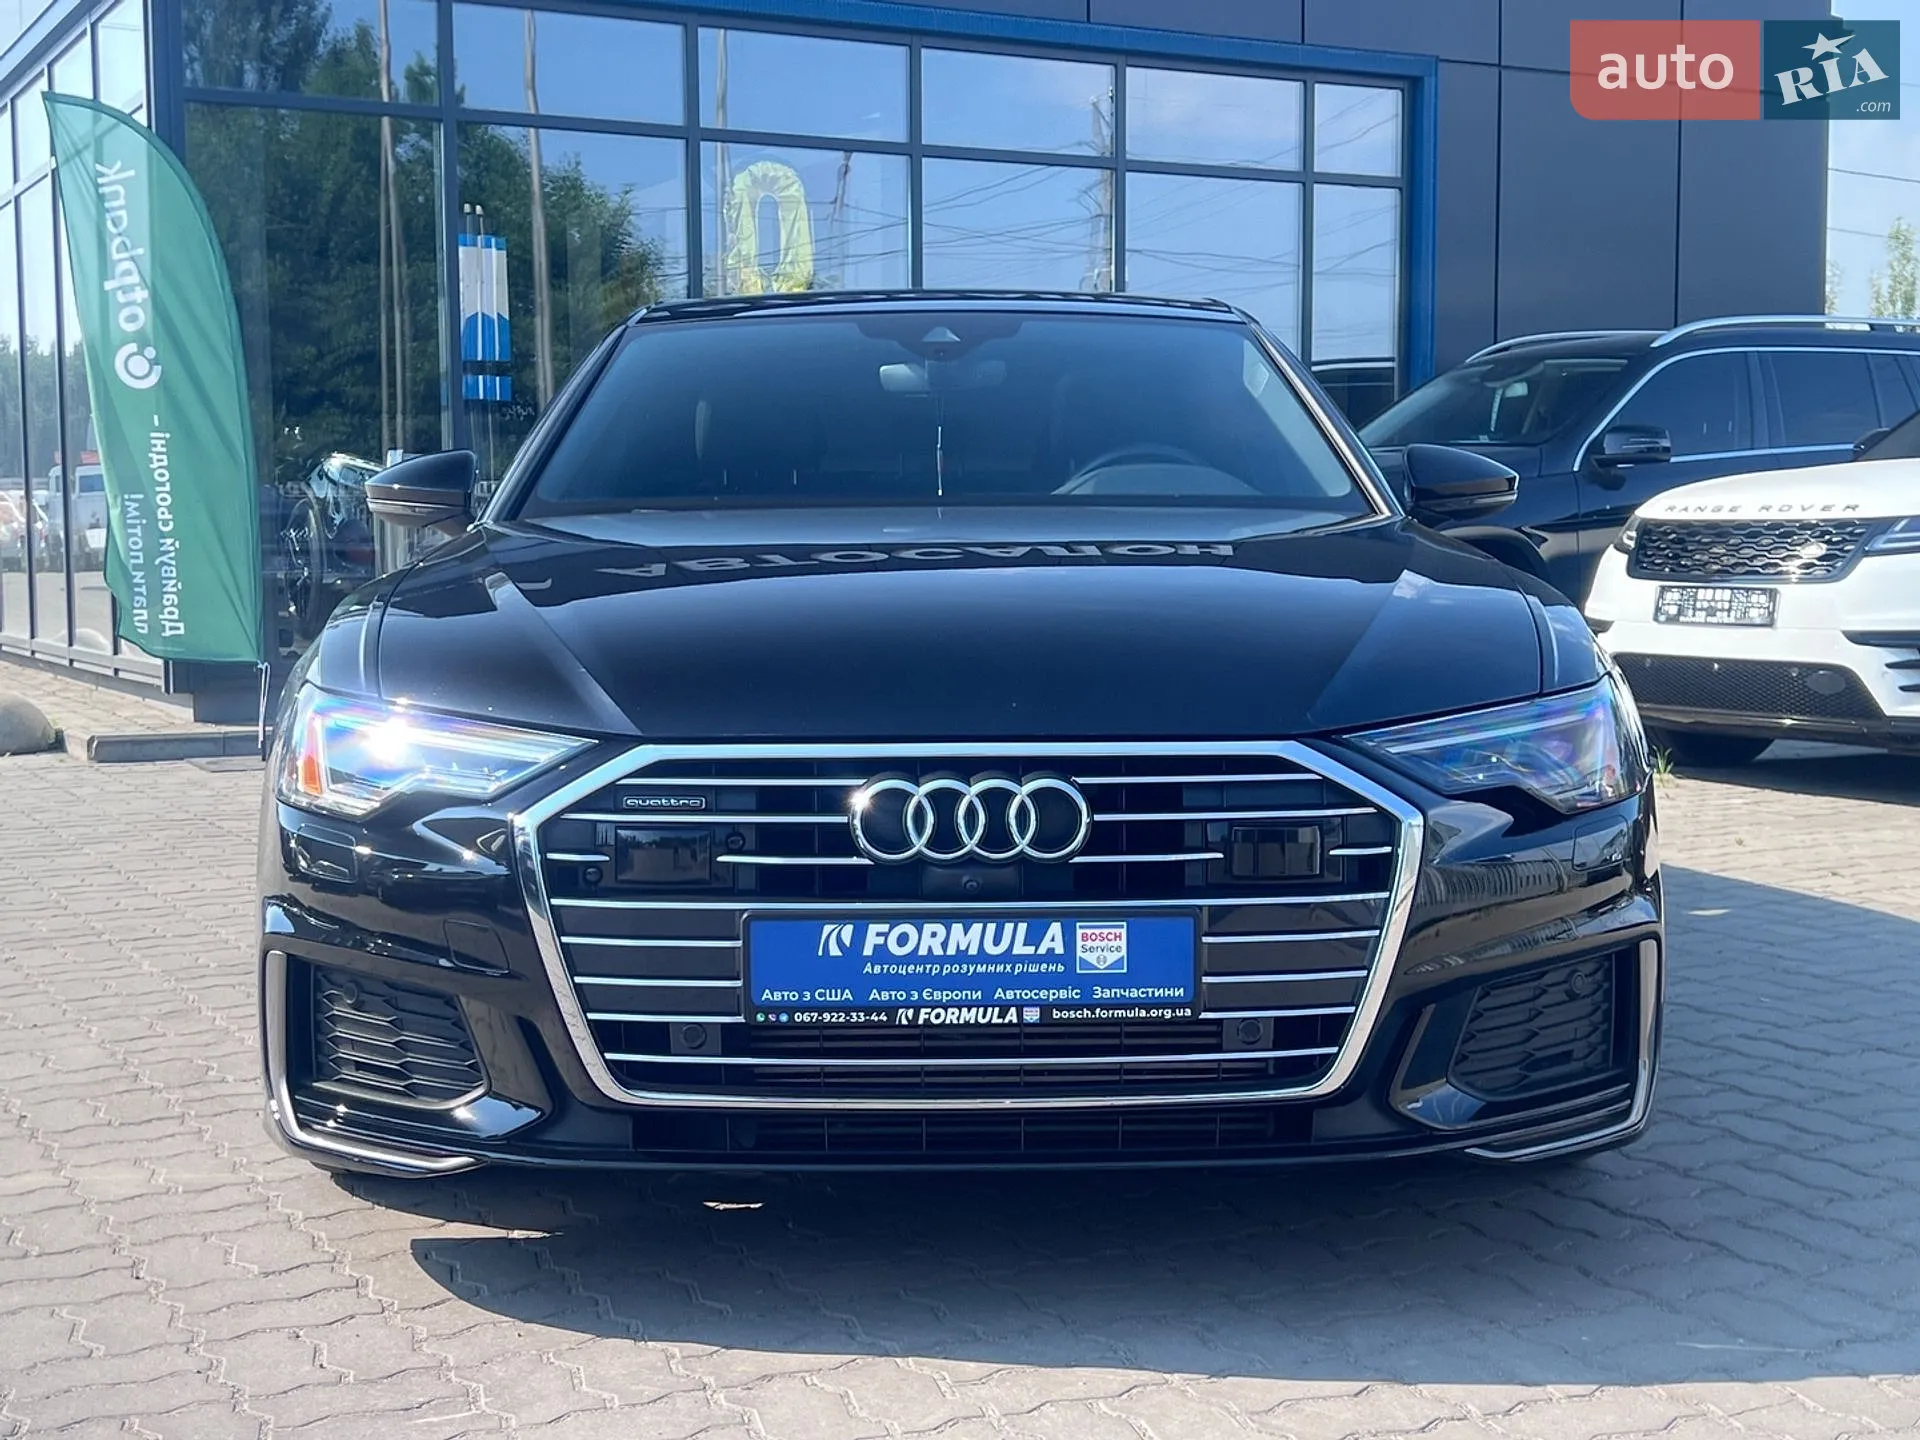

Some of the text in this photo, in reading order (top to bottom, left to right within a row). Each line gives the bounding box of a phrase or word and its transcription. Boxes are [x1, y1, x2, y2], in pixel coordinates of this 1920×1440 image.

[1665, 504, 1860, 513] RANGE ROVER
[625, 798, 702, 808] quattro
[863, 922, 1065, 957] FORMULA
[1081, 931, 1122, 942] BOSCH
[1081, 943, 1122, 954] Service
[863, 960, 1065, 976] Автоцентр розумних рішень
[762, 986, 1185, 1003] Авто з США Авто з Європи Автосервіс Запчастини
[794, 1012, 888, 1023] 067-922-33-44
[918, 1006, 1018, 1024] FORMULA
[1052, 1007, 1192, 1019] bosch.formula.org.ua
